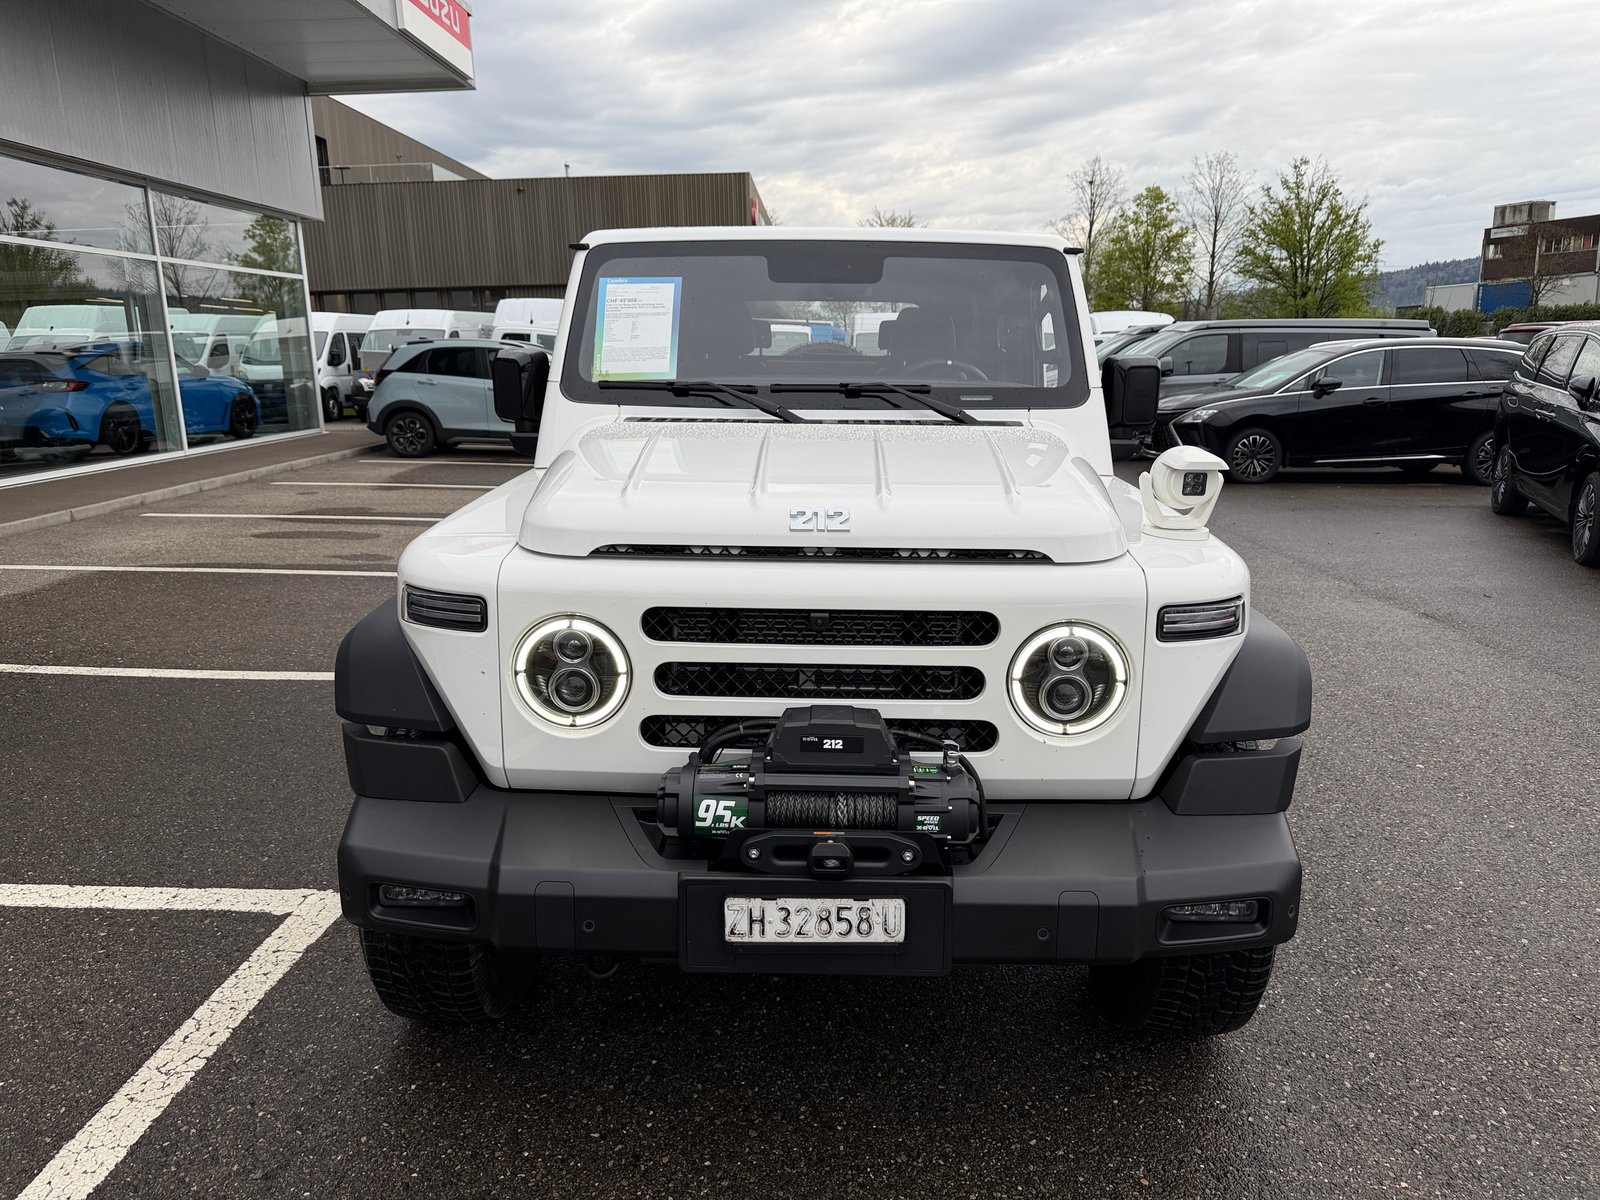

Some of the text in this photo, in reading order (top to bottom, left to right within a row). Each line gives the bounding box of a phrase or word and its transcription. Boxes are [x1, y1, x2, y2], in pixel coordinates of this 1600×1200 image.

[789, 505, 851, 533] 212
[823, 739, 843, 749] 212
[726, 903, 903, 938] ZH 32858 U
